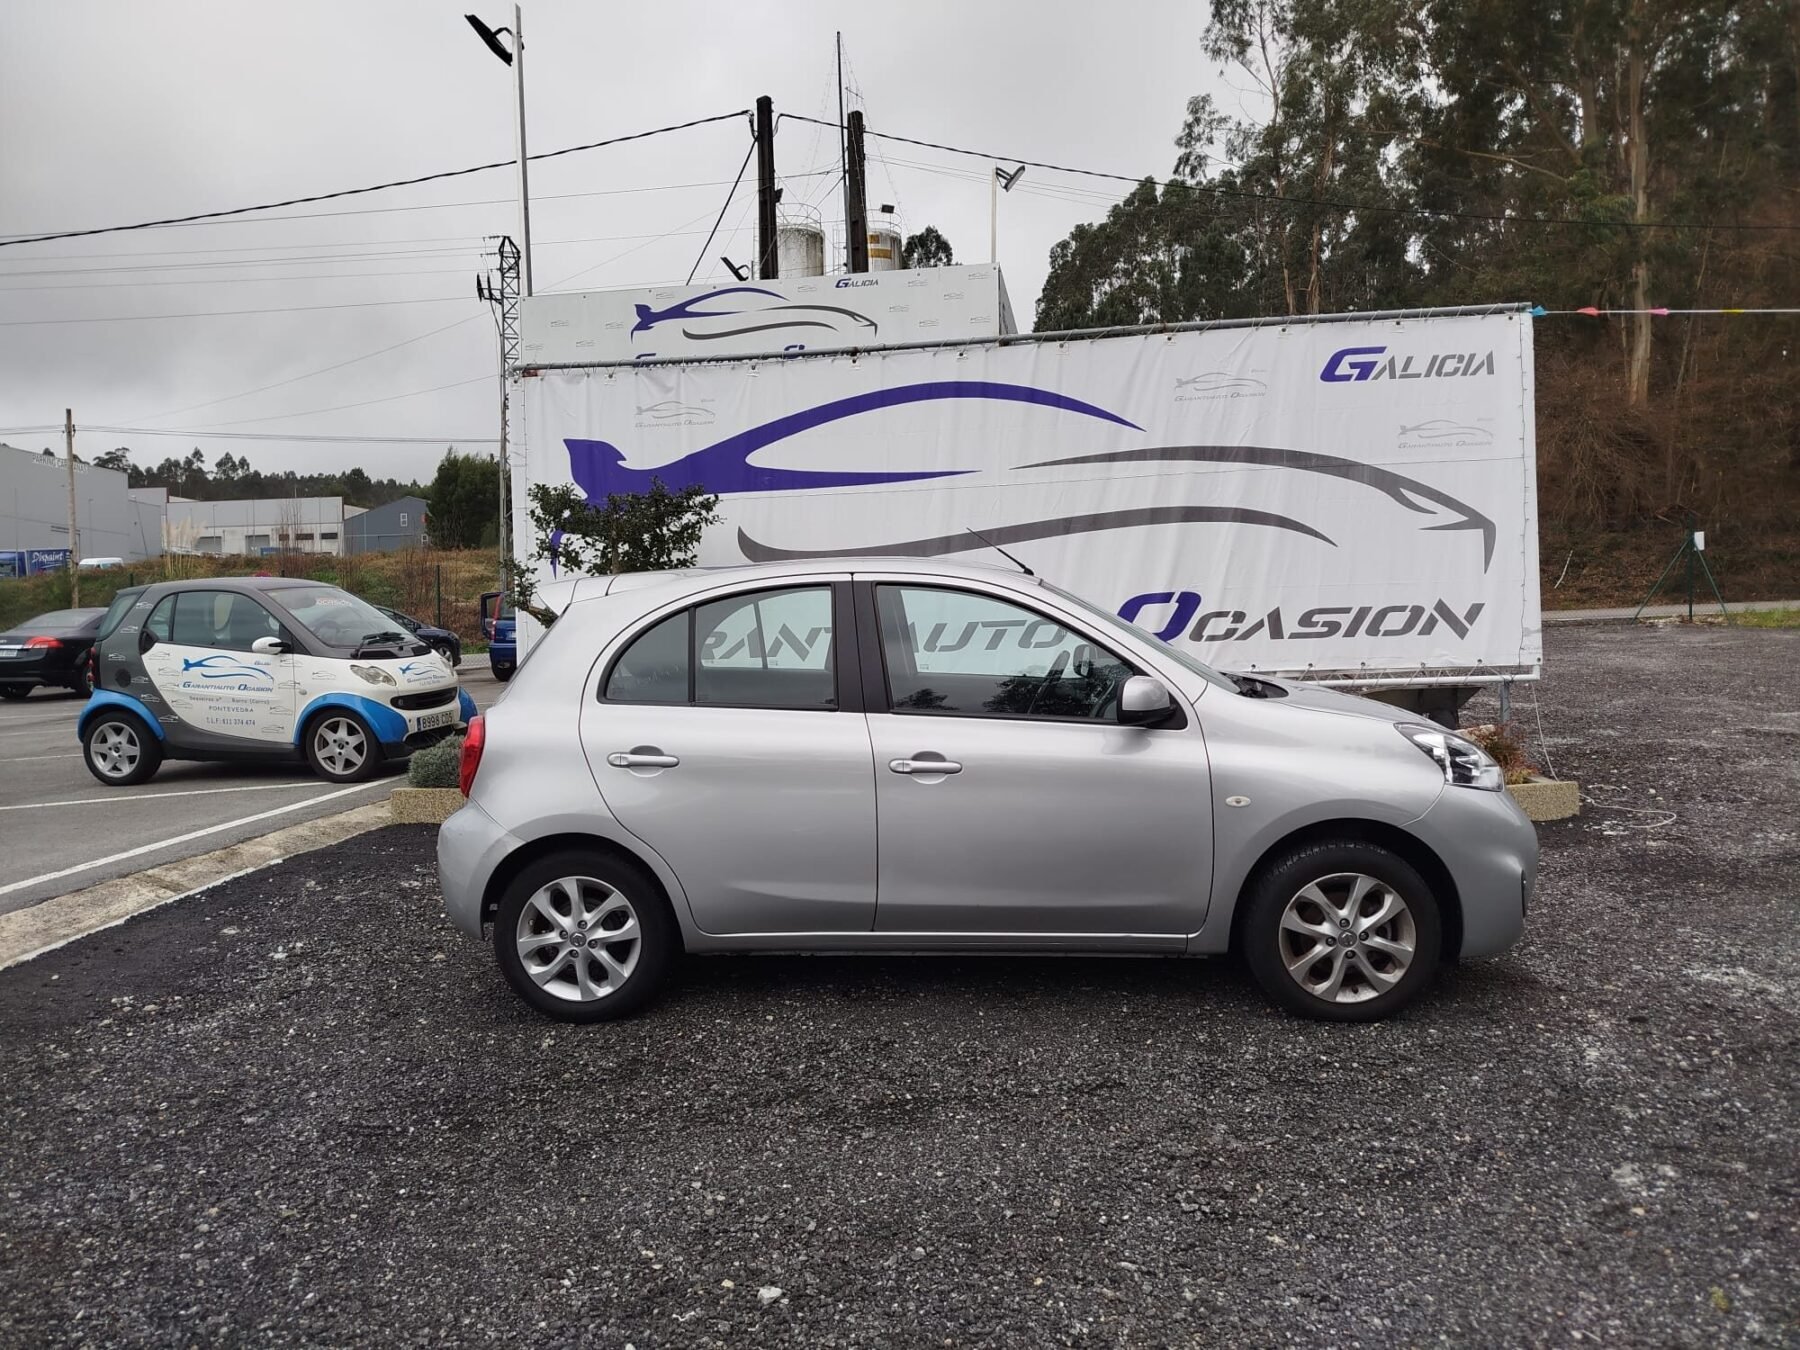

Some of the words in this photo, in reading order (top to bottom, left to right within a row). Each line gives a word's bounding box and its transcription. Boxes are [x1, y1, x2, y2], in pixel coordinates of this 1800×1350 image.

[835, 278, 879, 288] GALICIA
[1319, 345, 1495, 382] GALICIA
[1117, 591, 1486, 643] OCASION
[209, 705, 254, 713] PONTEVEDRA
[422, 714, 440, 729] 8998
